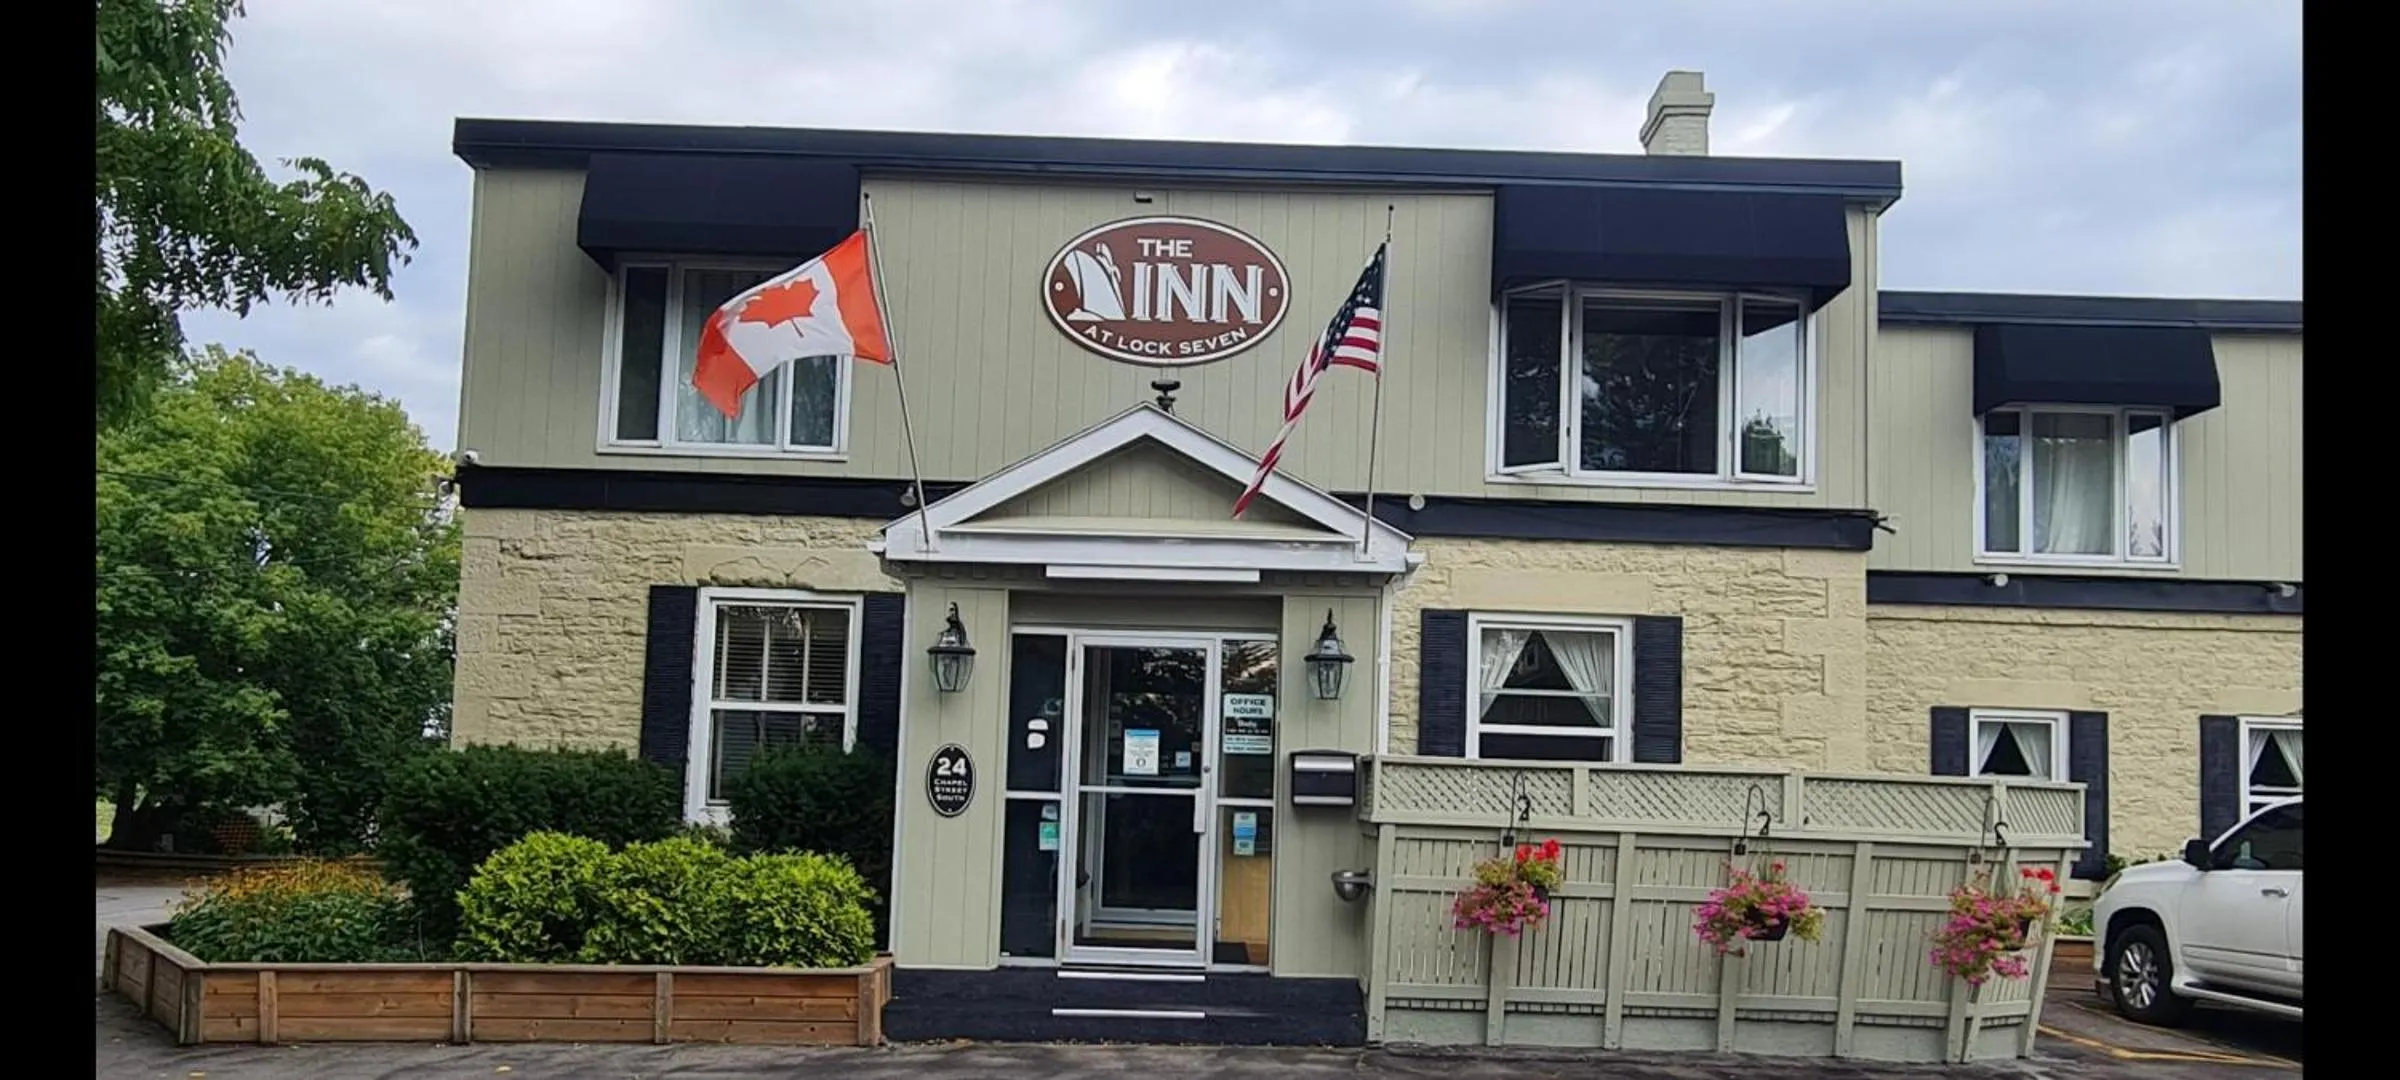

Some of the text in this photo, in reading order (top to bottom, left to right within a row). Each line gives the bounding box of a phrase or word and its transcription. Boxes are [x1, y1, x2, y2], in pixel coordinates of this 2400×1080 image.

[1137, 239, 1193, 257] THE
[1132, 261, 1265, 324] INN
[1084, 325, 1248, 355] AT LOCK SEVEN
[1230, 697, 1266, 706] OFFICE
[1233, 707, 1263, 715] HOURS
[937, 757, 967, 776] 24
